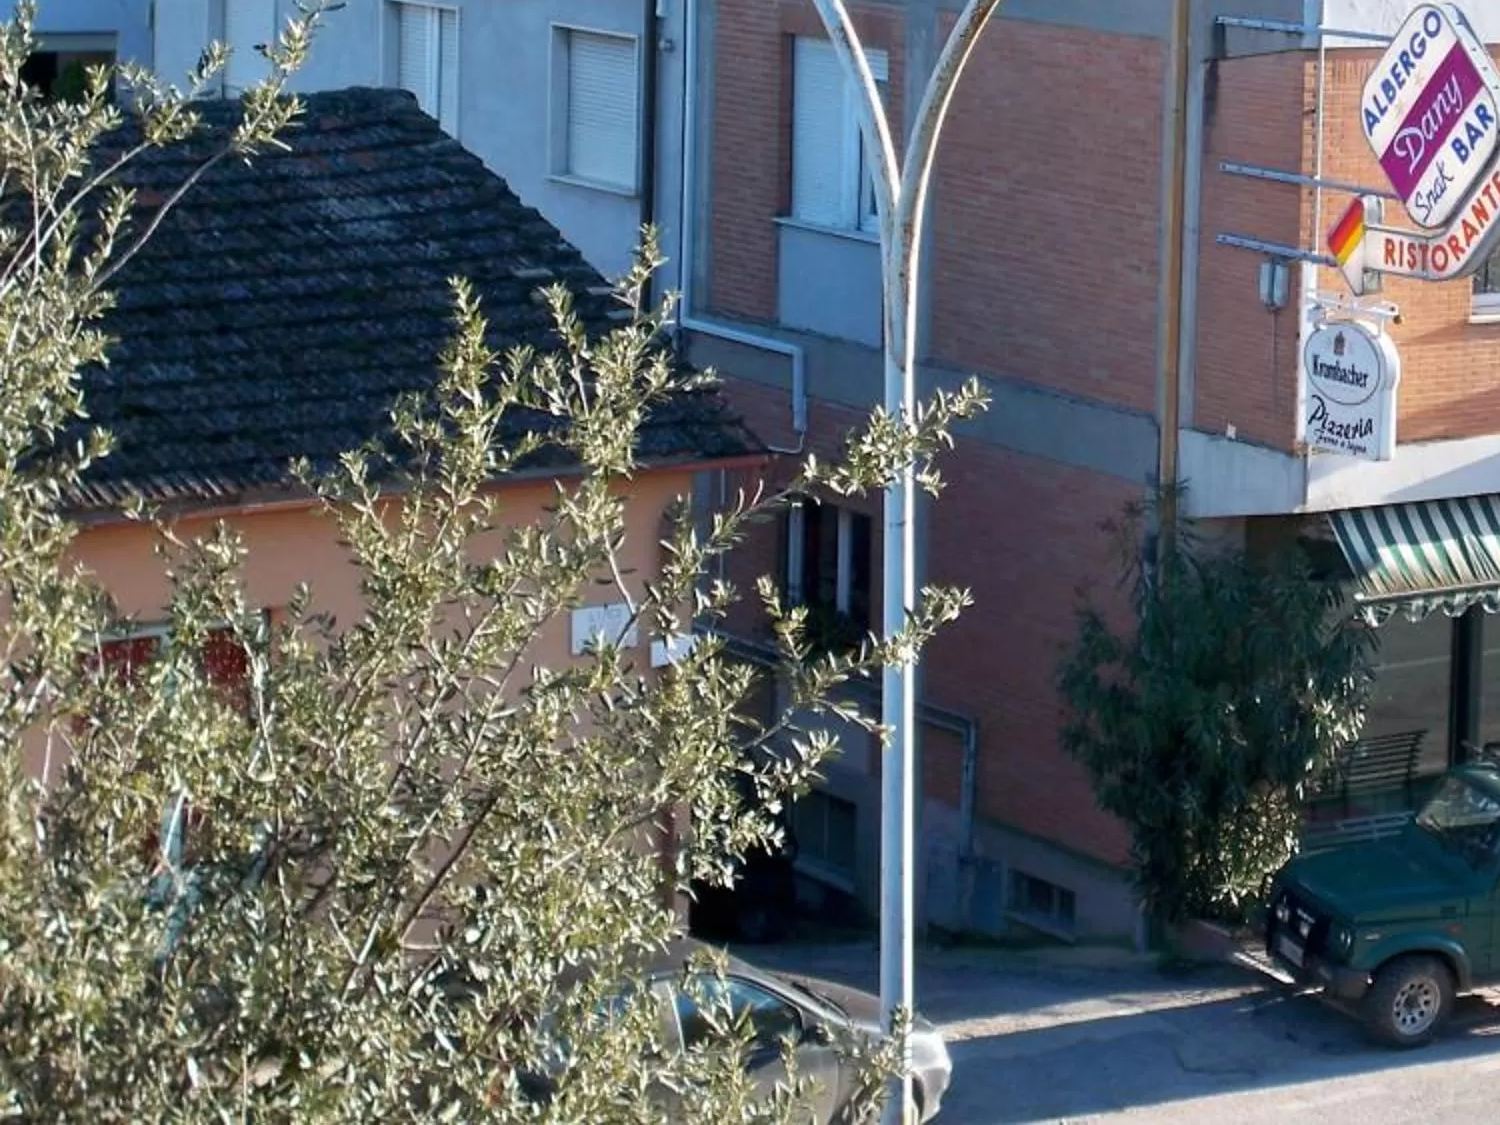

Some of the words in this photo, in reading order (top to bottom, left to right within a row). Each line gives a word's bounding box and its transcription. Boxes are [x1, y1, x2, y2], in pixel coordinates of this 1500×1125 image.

[1364, 10, 1441, 136] ALBERGO
[1393, 73, 1464, 174] Dany
[1451, 103, 1495, 165] BAR
